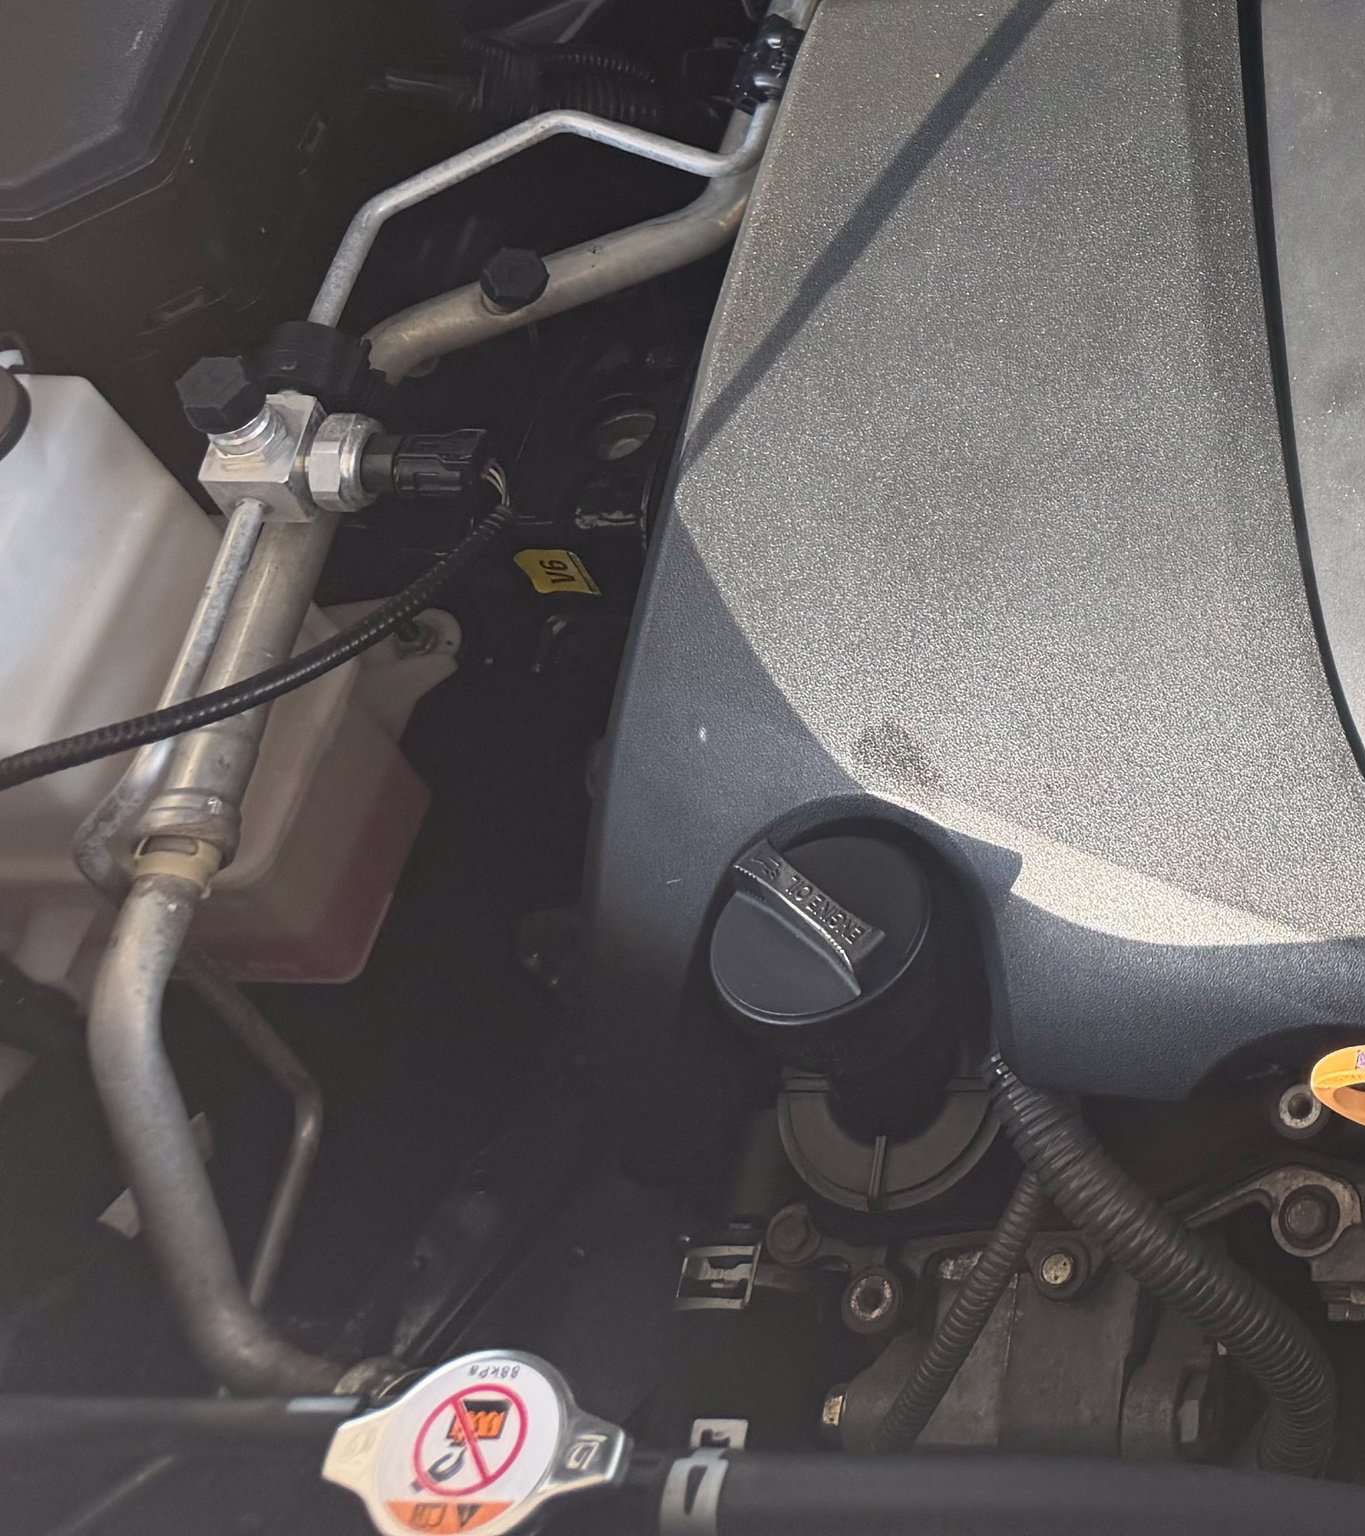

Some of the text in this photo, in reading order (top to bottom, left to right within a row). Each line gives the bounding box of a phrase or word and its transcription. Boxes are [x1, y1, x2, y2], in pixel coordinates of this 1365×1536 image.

[539, 559, 576, 584] V6
[784, 874, 864, 945] ENGINE OIL
